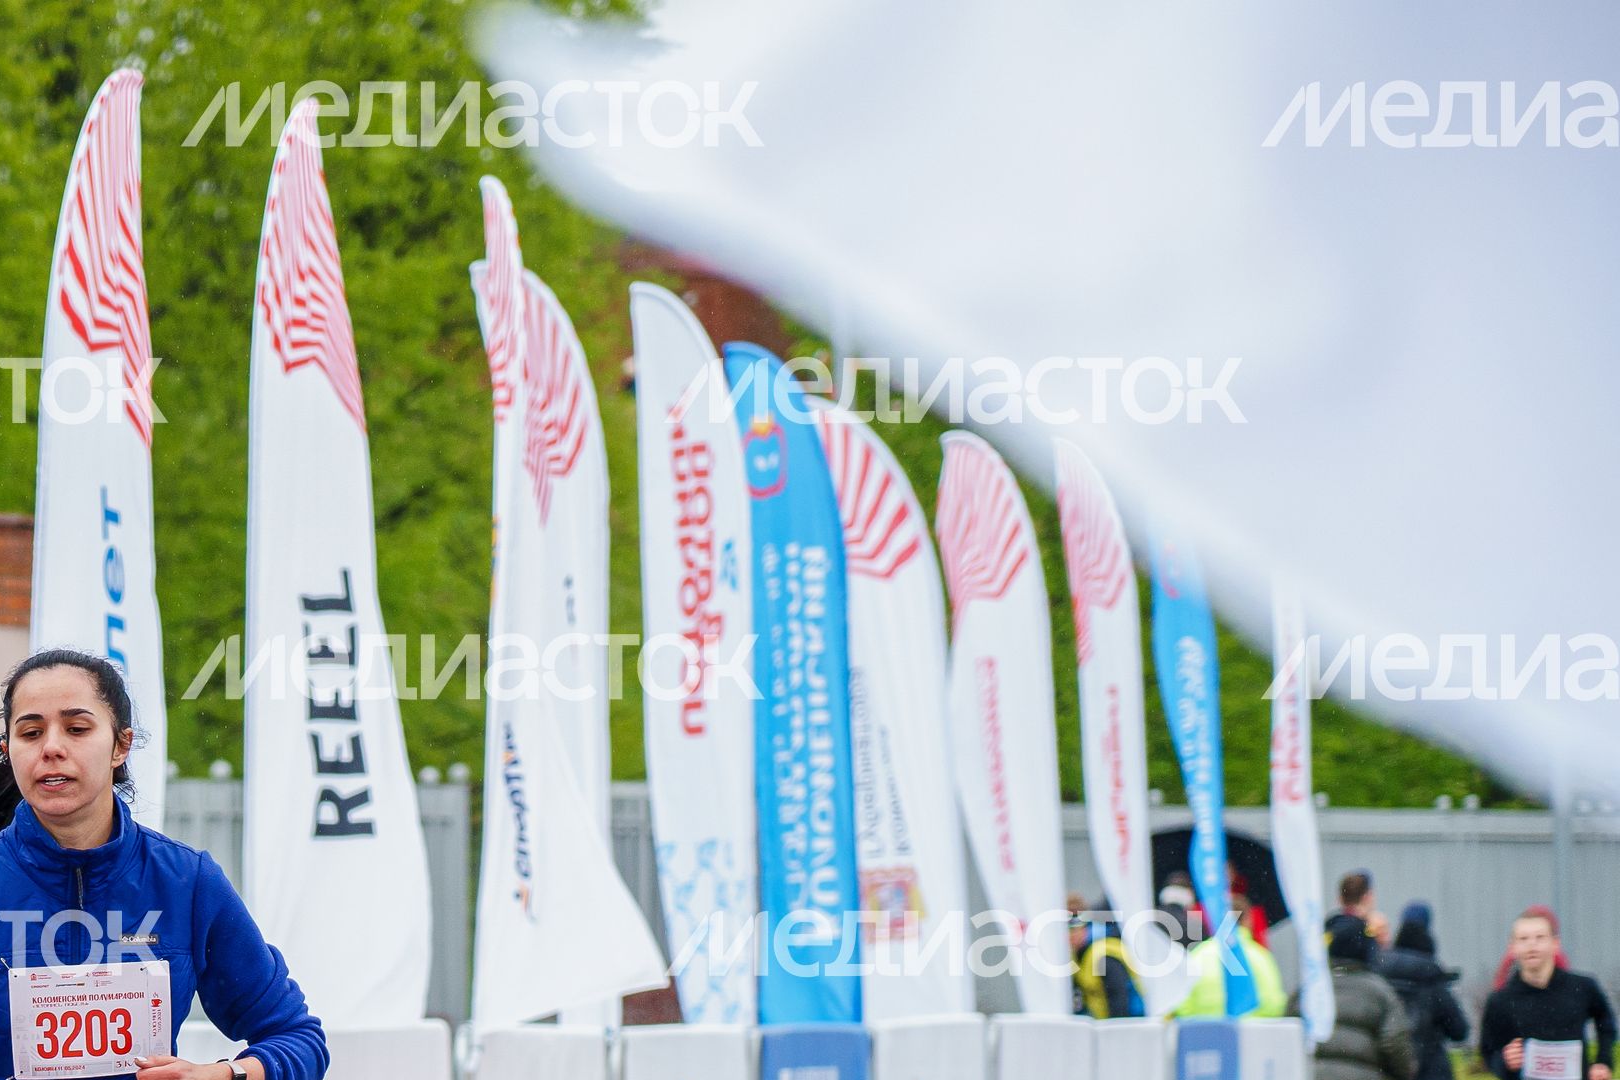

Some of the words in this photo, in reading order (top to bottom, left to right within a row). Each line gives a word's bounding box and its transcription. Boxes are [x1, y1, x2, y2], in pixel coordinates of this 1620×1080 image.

[32, 993, 87, 1004] КОЛОМЕНСКИЙ
[89, 991, 145, 1002] ПОЛУМАРАФОН
[35, 1008, 133, 1059] 3203
